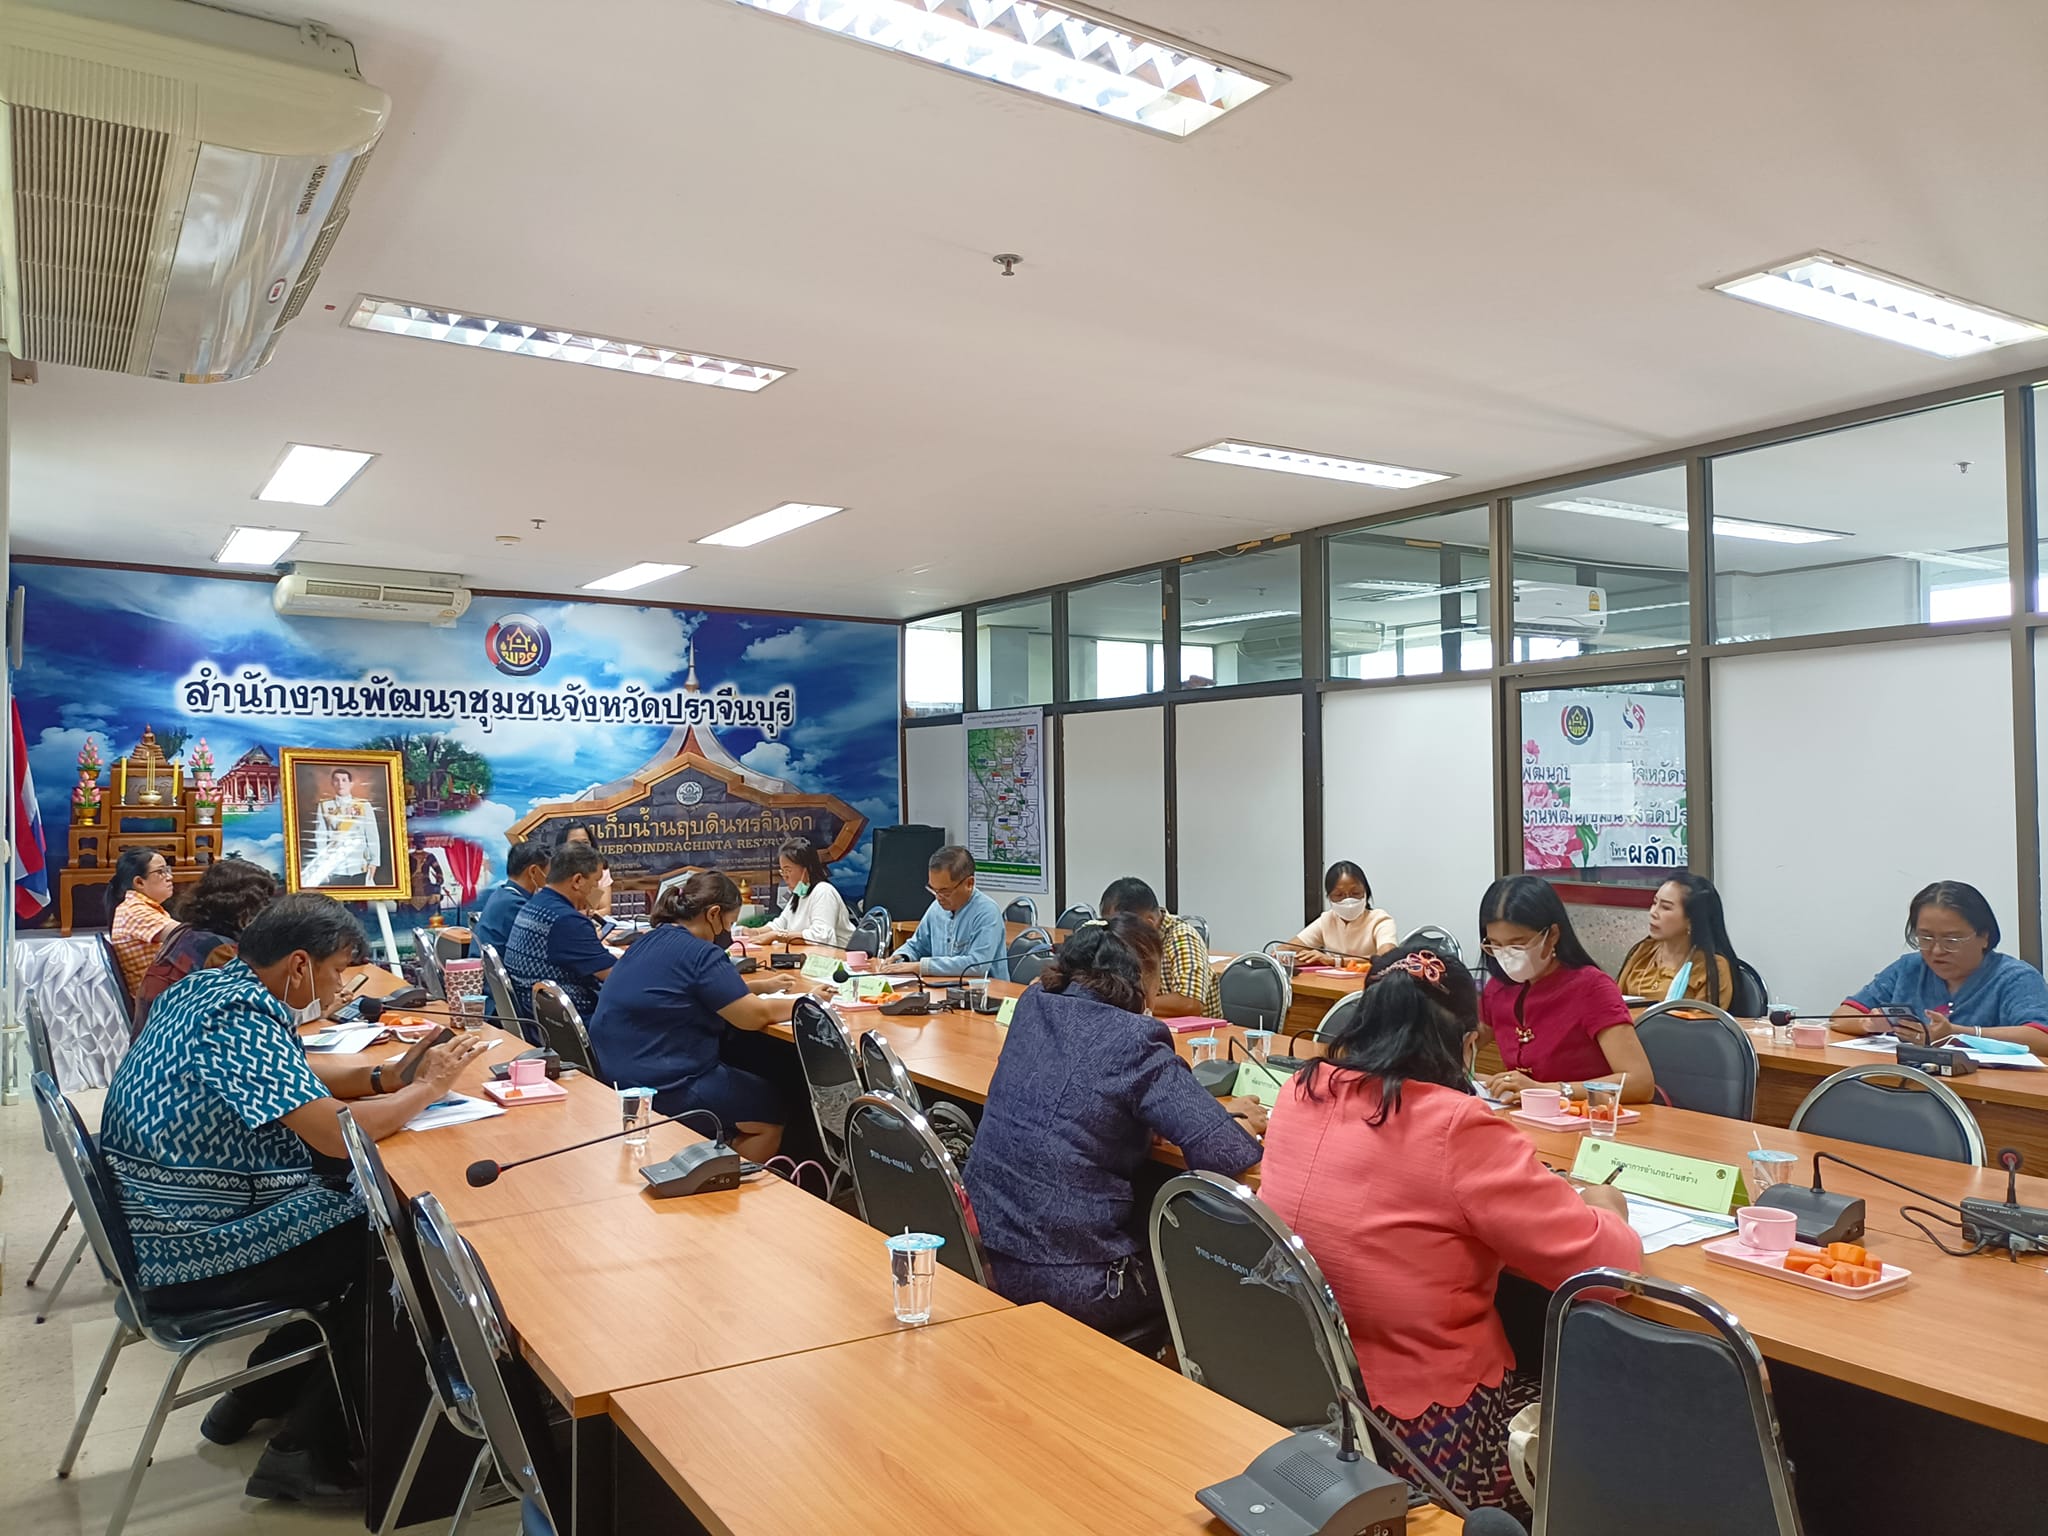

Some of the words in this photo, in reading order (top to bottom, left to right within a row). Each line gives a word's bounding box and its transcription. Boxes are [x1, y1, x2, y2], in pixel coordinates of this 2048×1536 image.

[183, 668, 795, 738] สำนักงานพัฒนาชุมชนจังหวัดปราจีนบุรี
[1628, 836, 1676, 865] ผลัก
